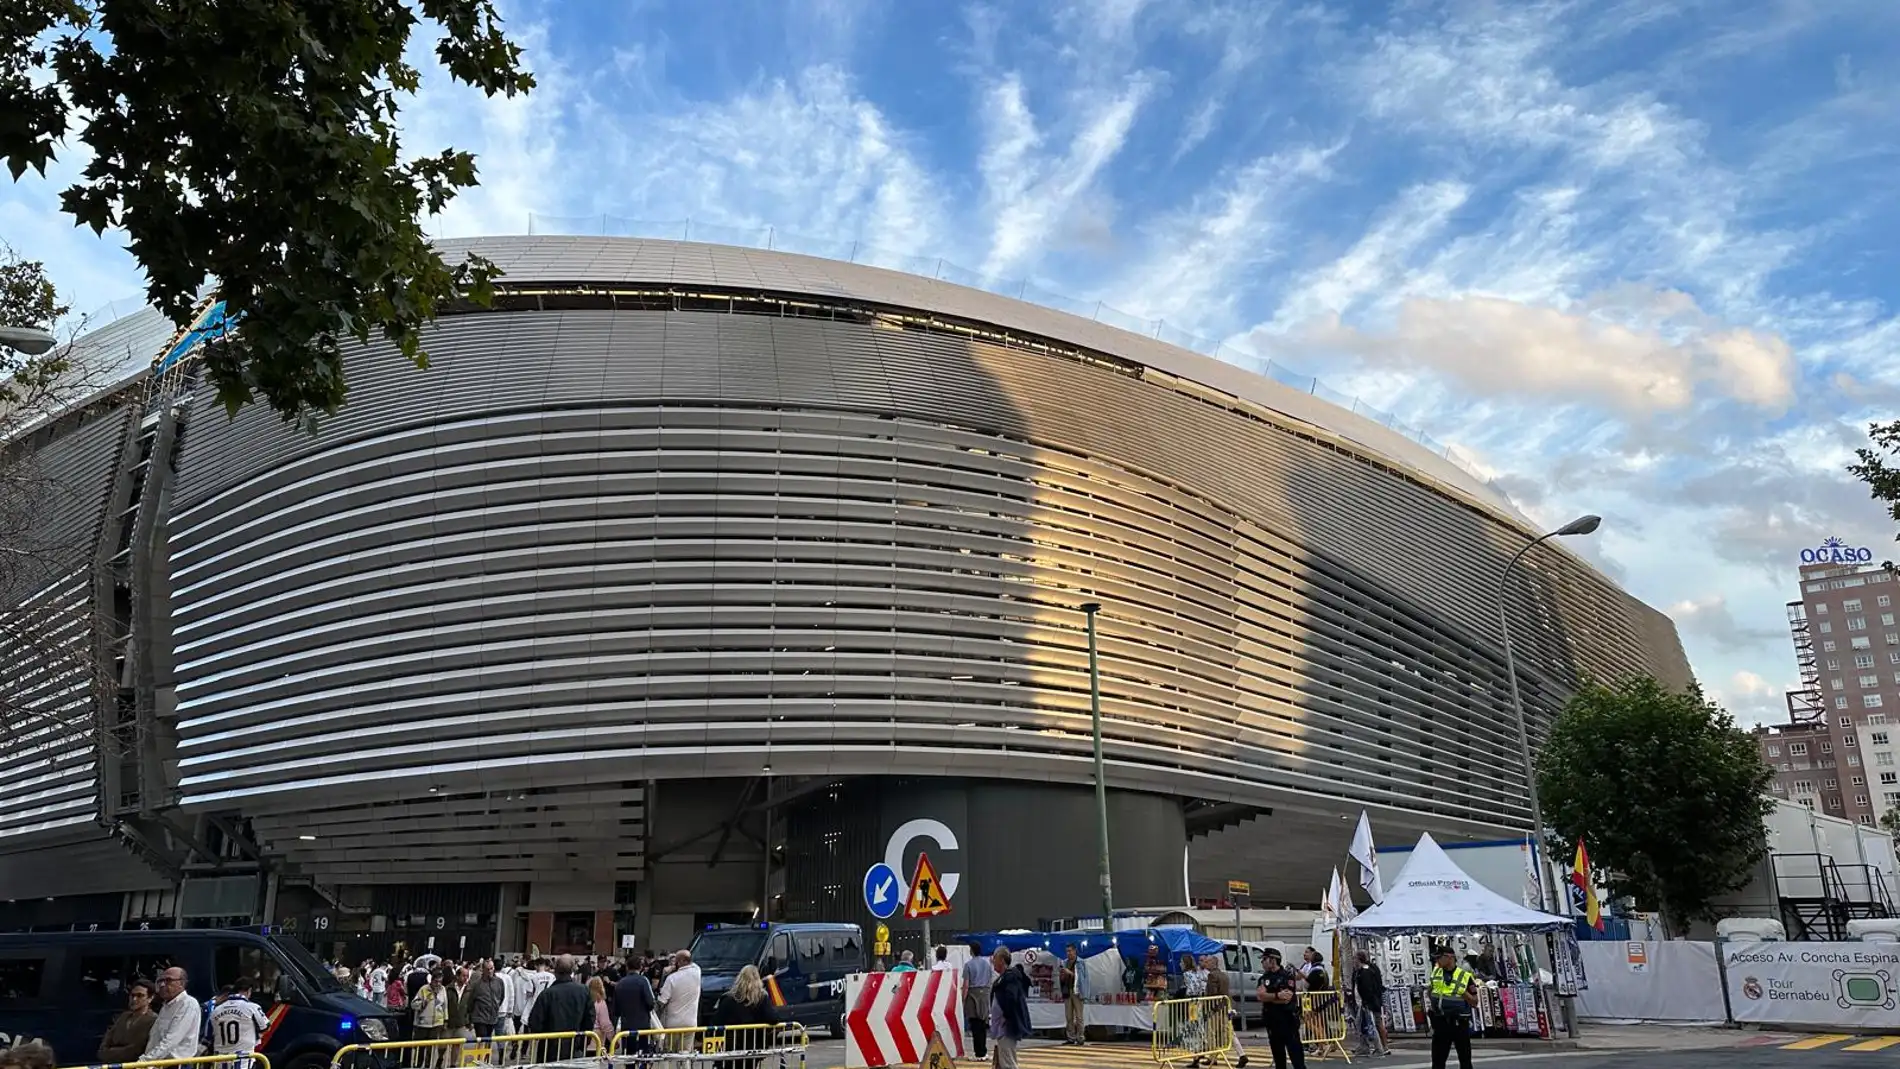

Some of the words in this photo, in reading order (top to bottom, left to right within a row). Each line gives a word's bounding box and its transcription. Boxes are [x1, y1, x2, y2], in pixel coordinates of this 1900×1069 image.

[1800, 547, 1872, 563] OCASO
[884, 818, 960, 906] C
[283, 917, 297, 930] 23
[314, 917, 329, 930] 19
[436, 916, 445, 930] 9
[1389, 940, 1401, 951] 12
[1458, 936, 1467, 950] 5
[1411, 953, 1424, 966] 15
[1730, 952, 1774, 963] Acceso
[1778, 952, 1797, 963] Av.
[1801, 952, 1850, 963] Concha
[1854, 952, 1899, 965] Espina
[1390, 962, 1402, 973] 21
[1413, 973, 1426, 985] 15
[1767, 978, 1794, 989] Tour
[1768, 989, 1830, 1001] Bernabéu
[219, 1020, 240, 1046] 10
